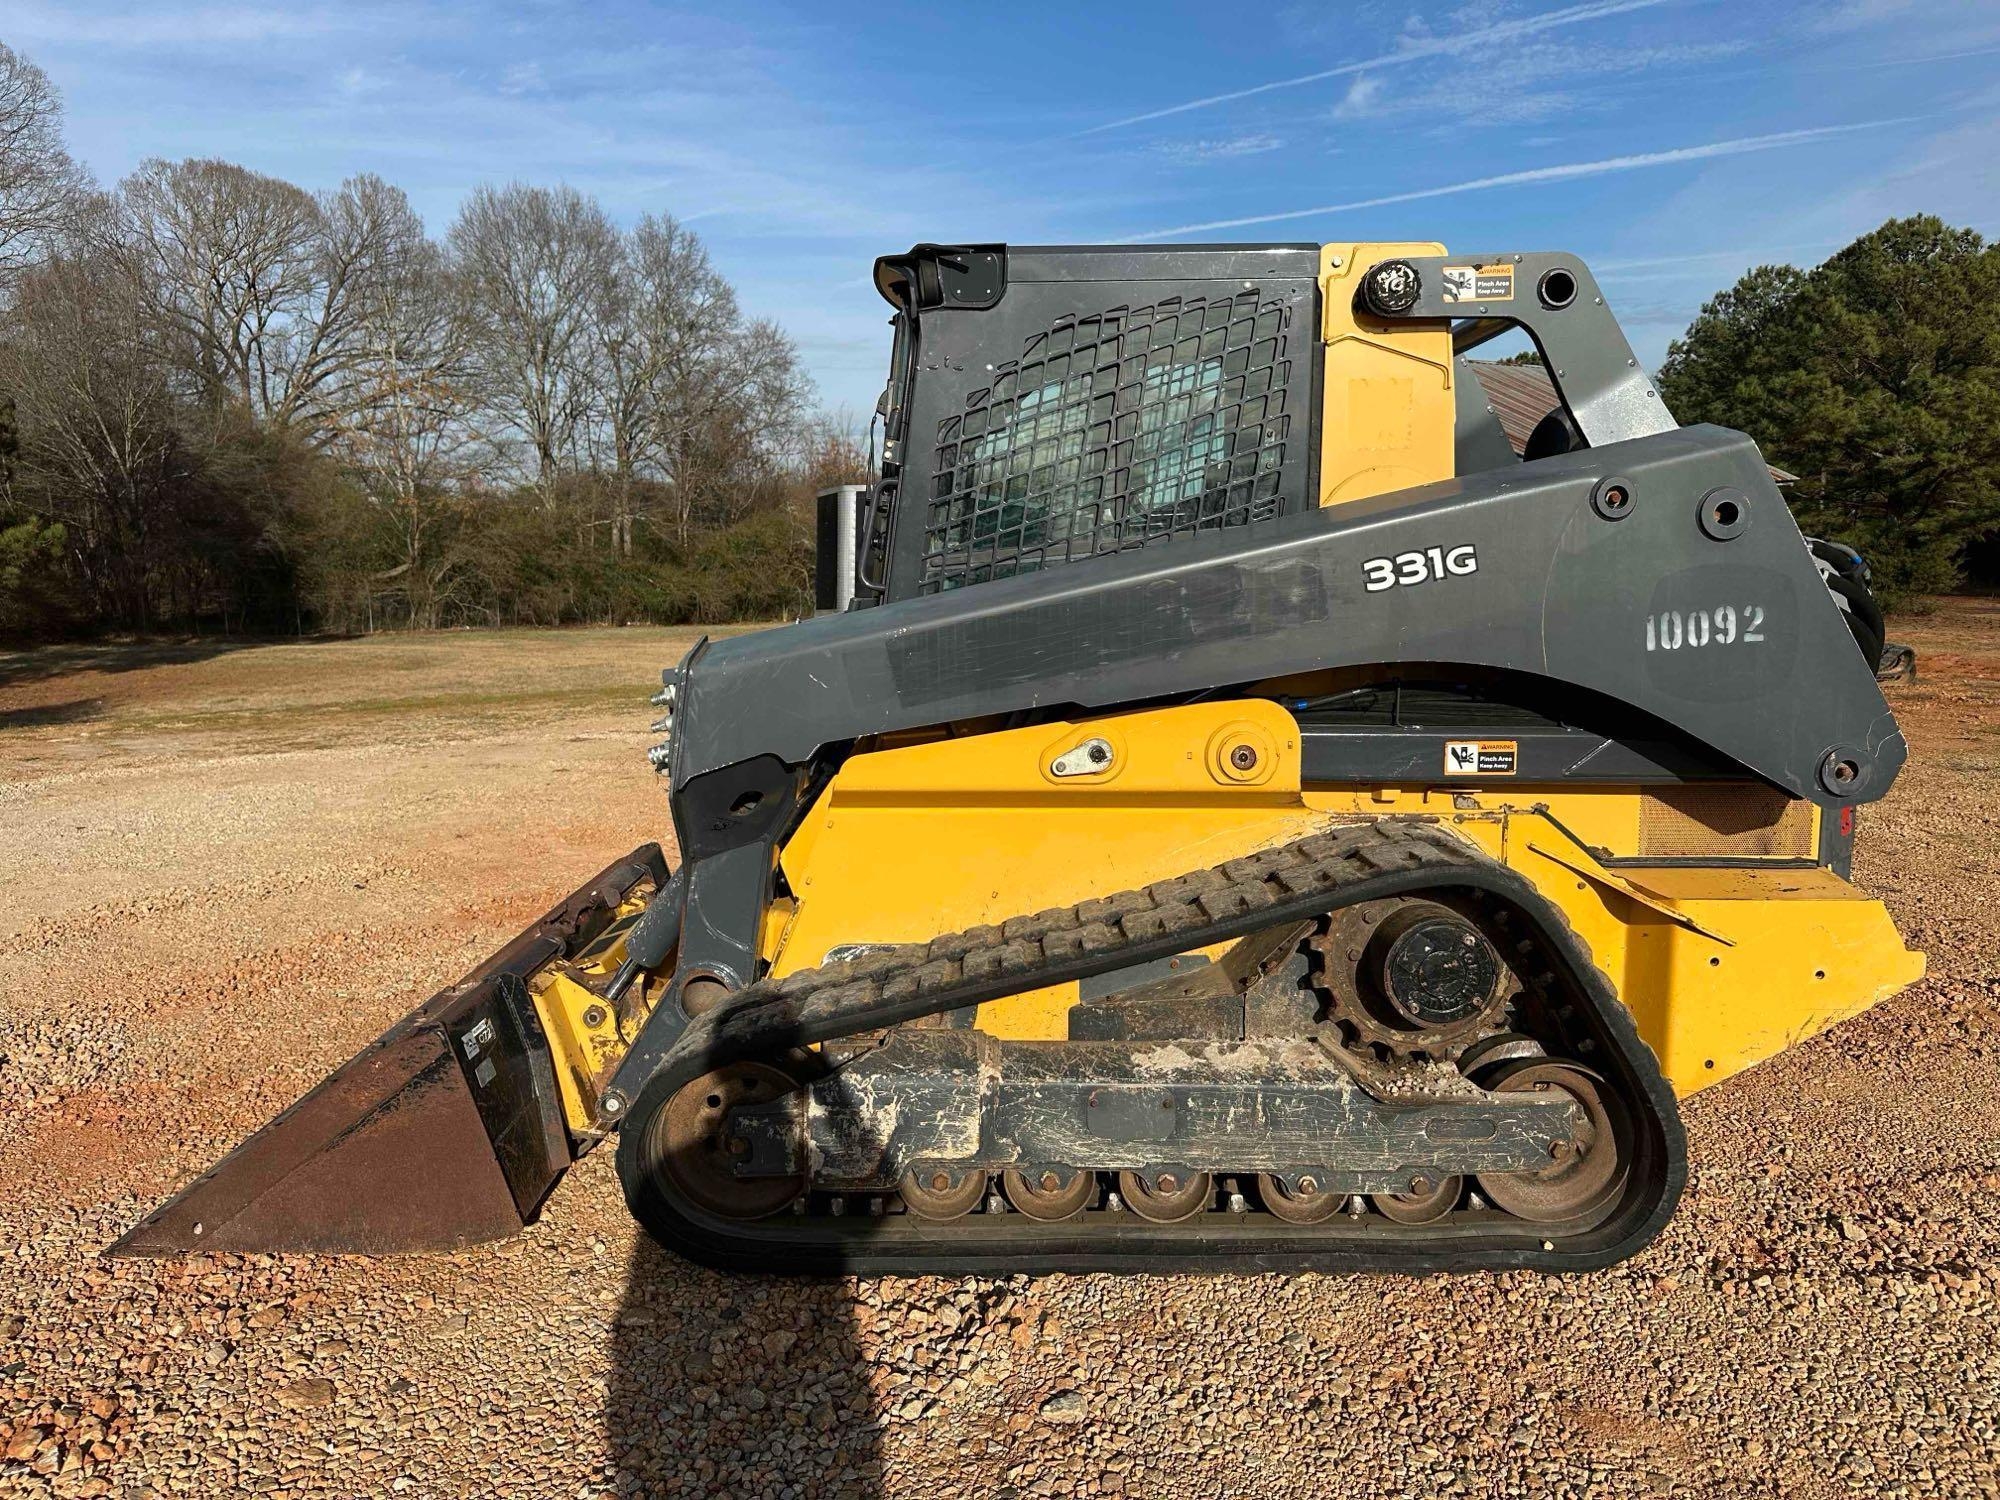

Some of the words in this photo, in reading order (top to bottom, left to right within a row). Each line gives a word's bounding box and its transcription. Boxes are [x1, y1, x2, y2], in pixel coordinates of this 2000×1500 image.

[1484, 267, 1511, 275] WARNING
[1362, 544, 1478, 592] 331G
[1646, 605, 1764, 651] 10092
